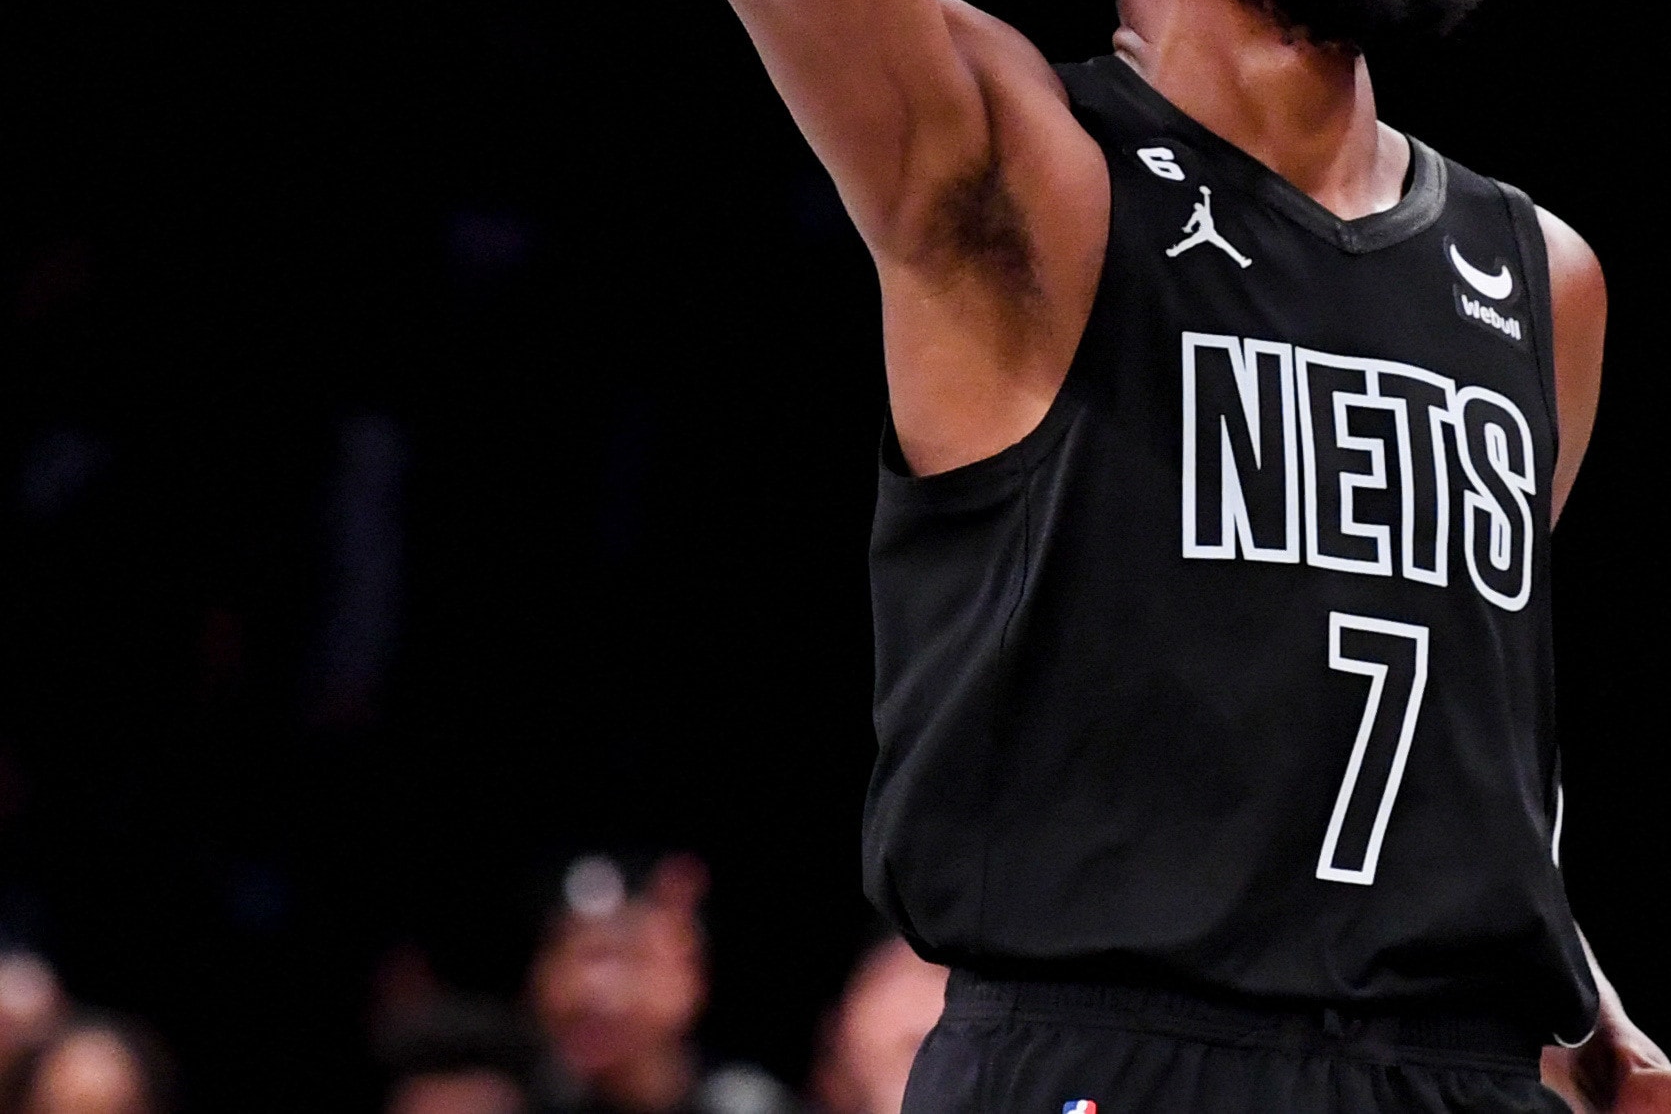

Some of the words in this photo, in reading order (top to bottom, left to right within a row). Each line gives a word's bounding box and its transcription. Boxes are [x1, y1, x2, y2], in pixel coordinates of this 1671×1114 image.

[1137, 147, 1185, 181] 6
[1461, 294, 1521, 340] Webull
[1182, 331, 1535, 611] NETS
[1316, 611, 1429, 885] 7
